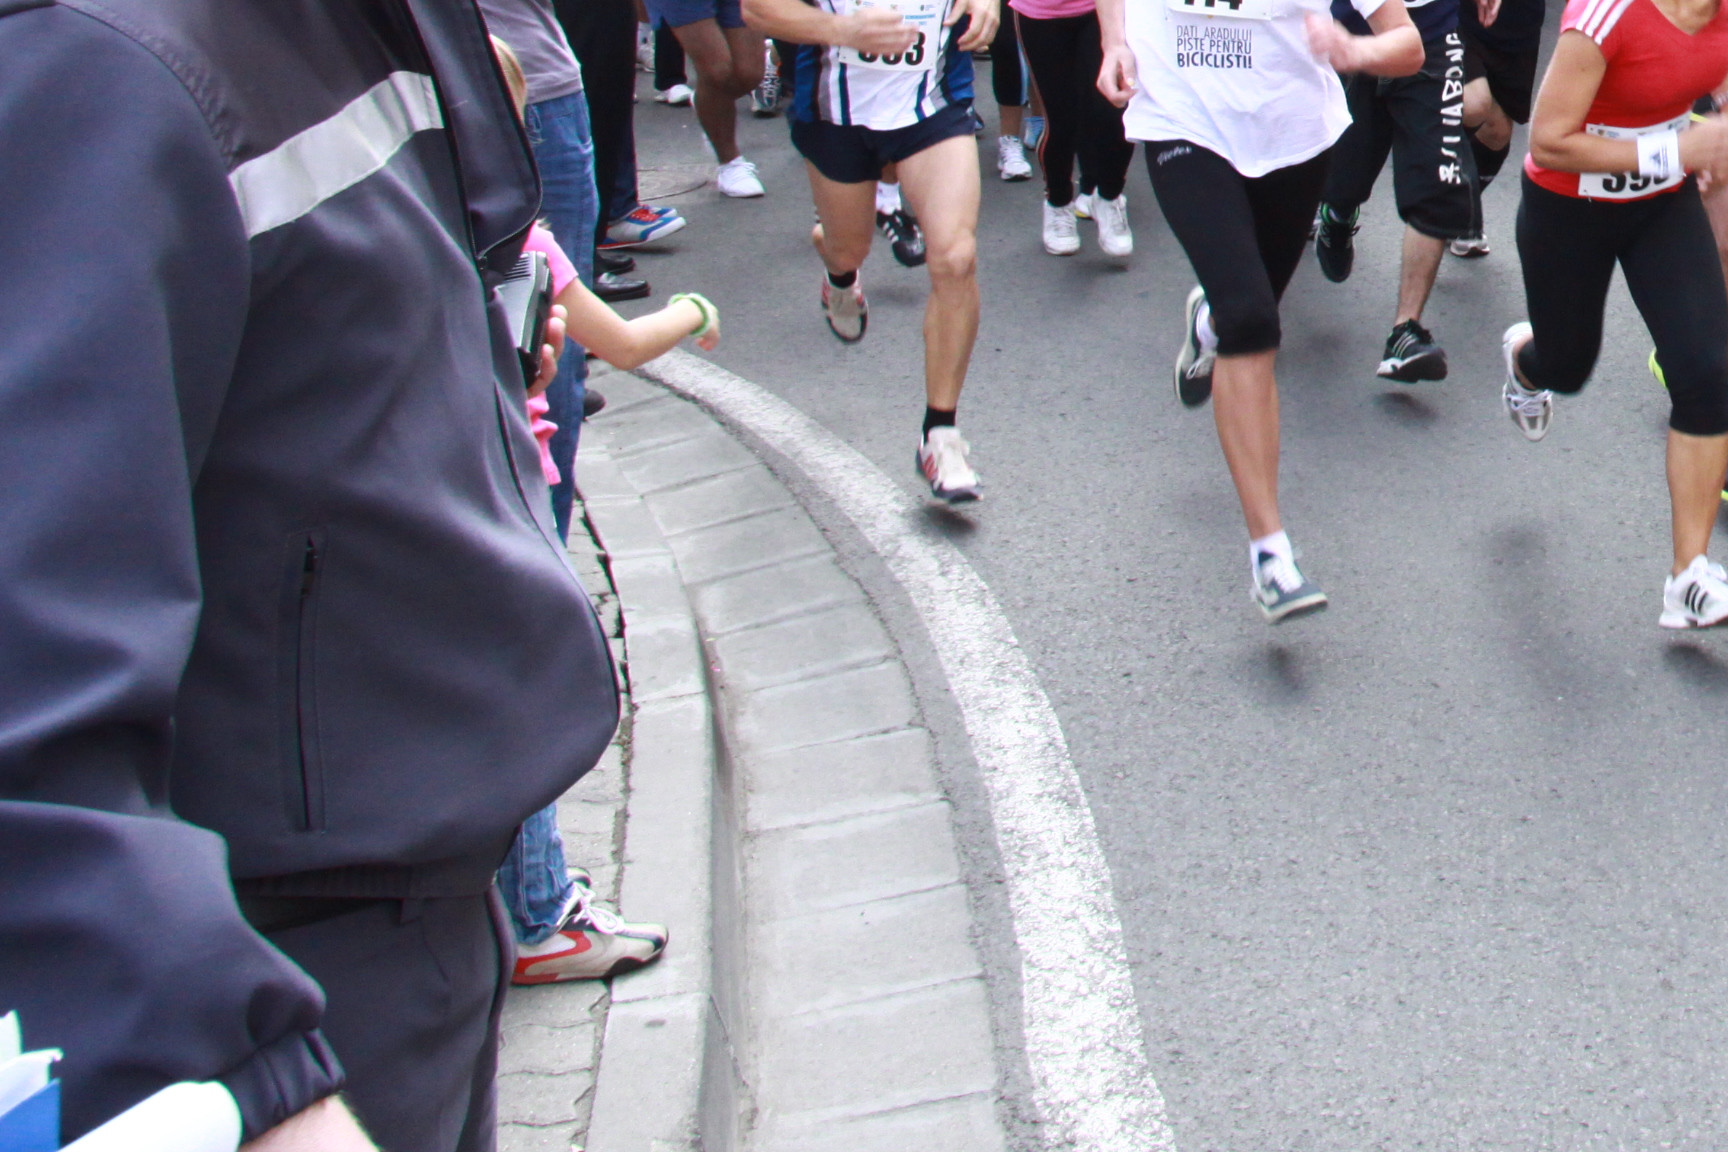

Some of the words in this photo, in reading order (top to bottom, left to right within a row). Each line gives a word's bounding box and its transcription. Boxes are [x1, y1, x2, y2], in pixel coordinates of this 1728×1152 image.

[1204, 26, 1252, 42] ARADULUI
[1176, 38, 1205, 52] PISTE
[1209, 39, 1252, 55] PENTRU
